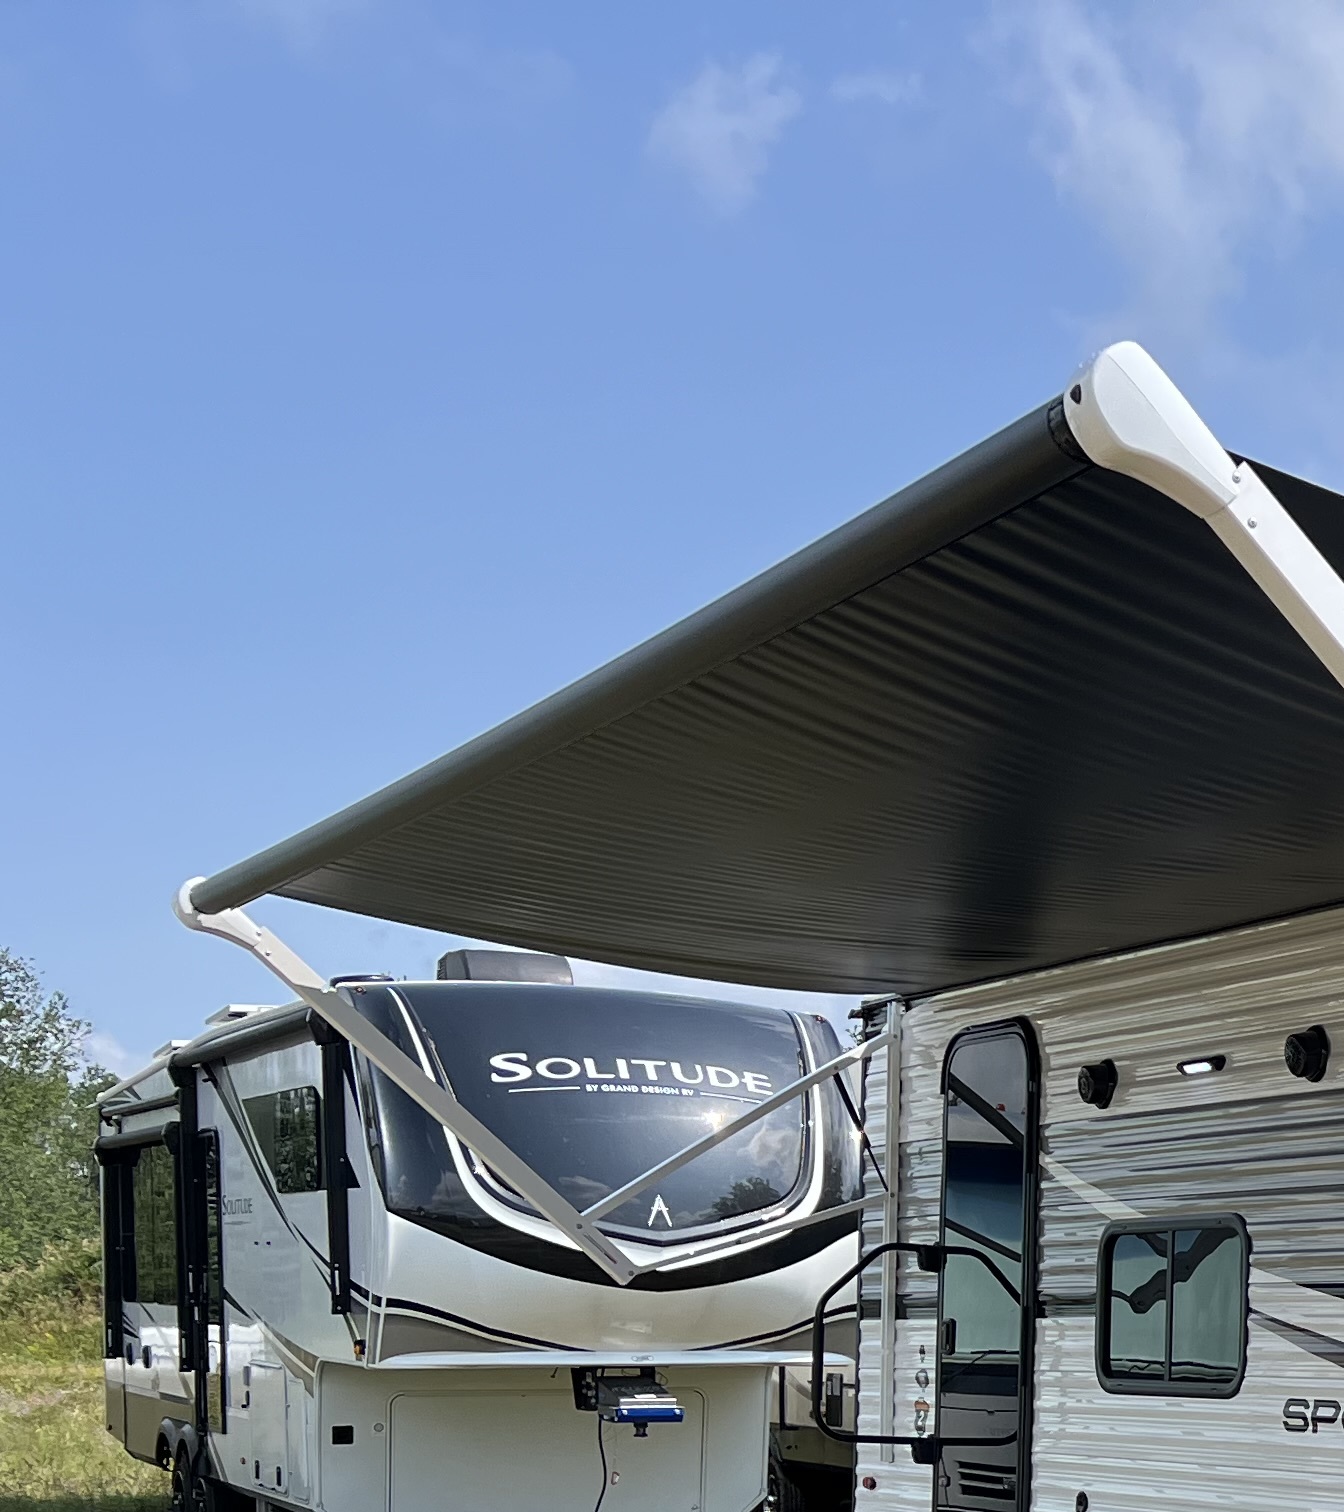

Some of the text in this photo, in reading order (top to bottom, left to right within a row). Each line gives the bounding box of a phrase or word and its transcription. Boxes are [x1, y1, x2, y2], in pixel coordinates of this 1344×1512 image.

[490, 1053, 774, 1095] SOLITUDE
[585, 1083, 694, 1096] BY GRAND DESIGN RV
